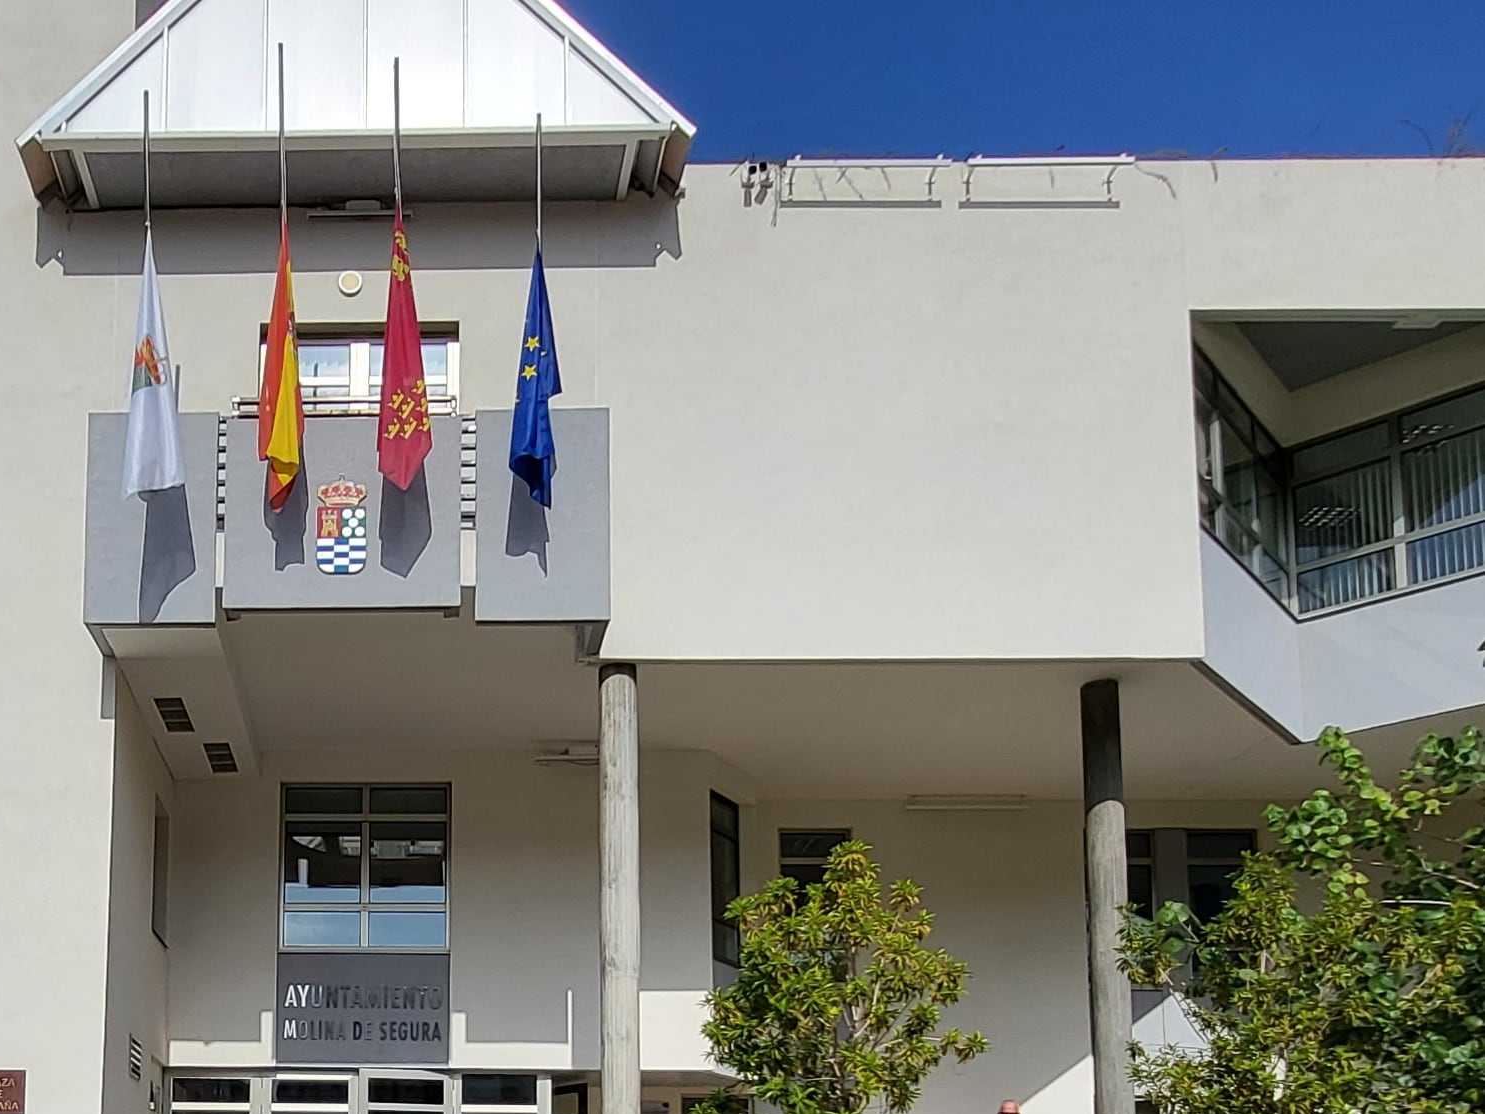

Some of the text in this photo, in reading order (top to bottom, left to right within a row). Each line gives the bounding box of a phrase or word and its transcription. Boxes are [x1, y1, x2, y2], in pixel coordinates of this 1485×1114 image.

[283, 984, 443, 1010] AYUNTAMIENTO
[282, 1019, 442, 1042] MOLINA DE SEGURA
